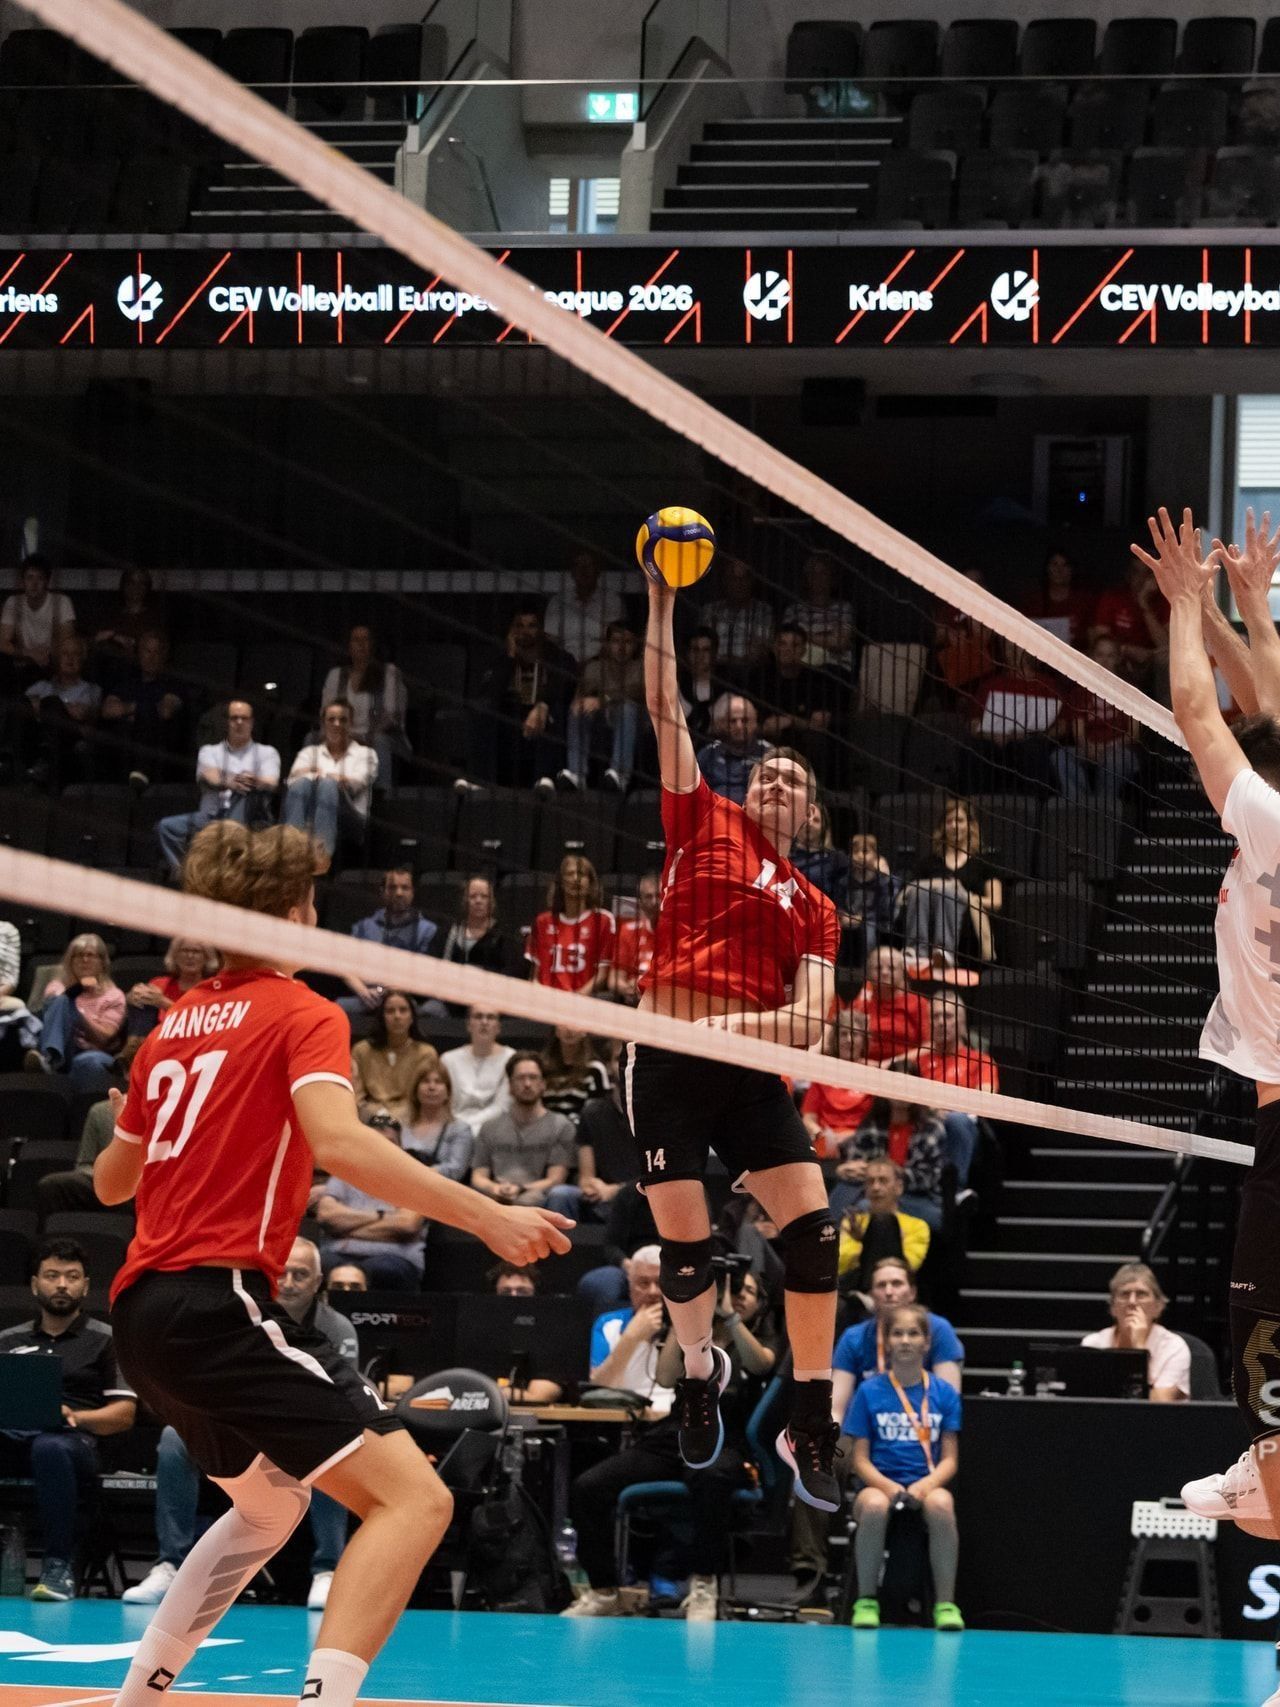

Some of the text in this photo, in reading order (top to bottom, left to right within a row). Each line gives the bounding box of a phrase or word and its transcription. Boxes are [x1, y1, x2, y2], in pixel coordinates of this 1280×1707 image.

[0, 286, 58, 313] riens
[208, 284, 693, 318] CEV Volleyball Europe eague 2026
[849, 283, 933, 312] Kriens
[1100, 284, 1159, 312] CEV
[645, 1147, 667, 1173] 14
